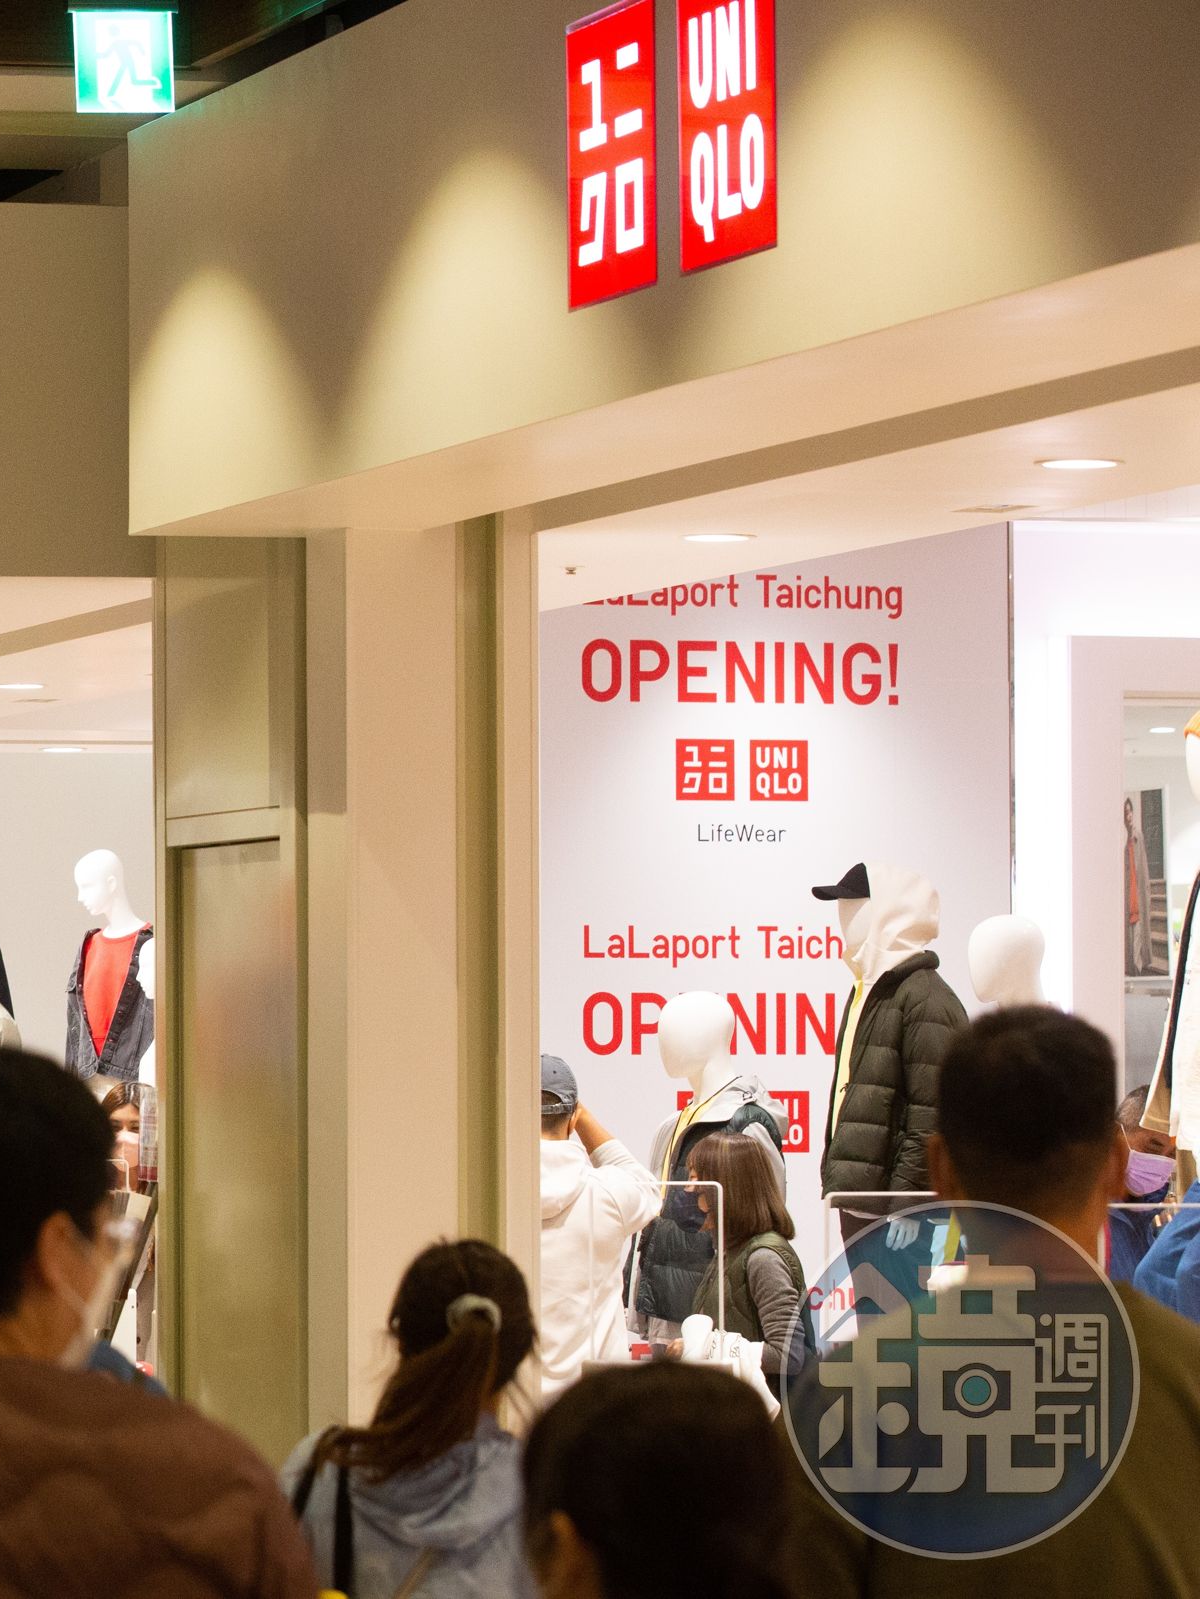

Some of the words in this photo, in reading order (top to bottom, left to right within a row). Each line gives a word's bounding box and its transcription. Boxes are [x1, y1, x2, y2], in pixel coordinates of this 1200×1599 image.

[583, 574, 740, 616] aport
[755, 574, 904, 620] Taichung
[581, 638, 900, 706] OPENING!
[697, 823, 787, 842] LifeWear
[583, 925, 741, 968] LaLaport
[757, 926, 843, 959] Taich
[582, 992, 836, 1056] OPNIN
